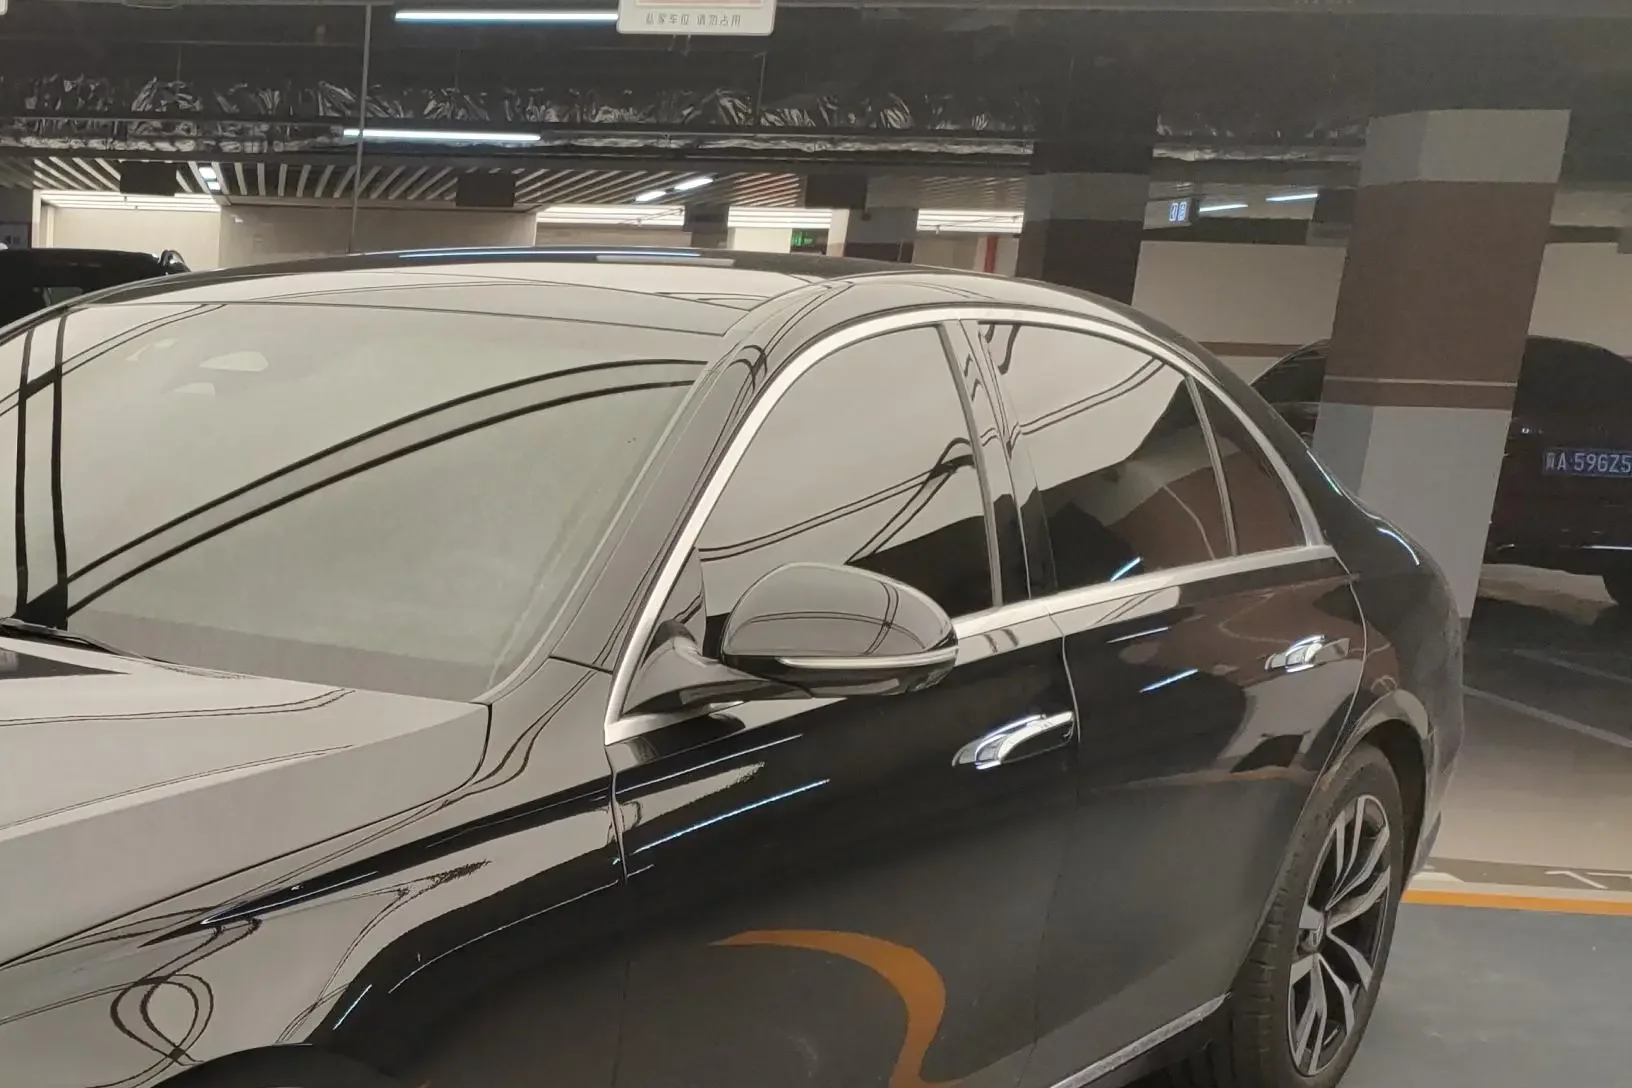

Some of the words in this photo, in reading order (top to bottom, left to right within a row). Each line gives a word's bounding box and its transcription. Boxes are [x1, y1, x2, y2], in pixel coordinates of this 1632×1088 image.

[646, 12, 690, 26] 私家车位
[697, 13, 742, 27] 请勿占用
